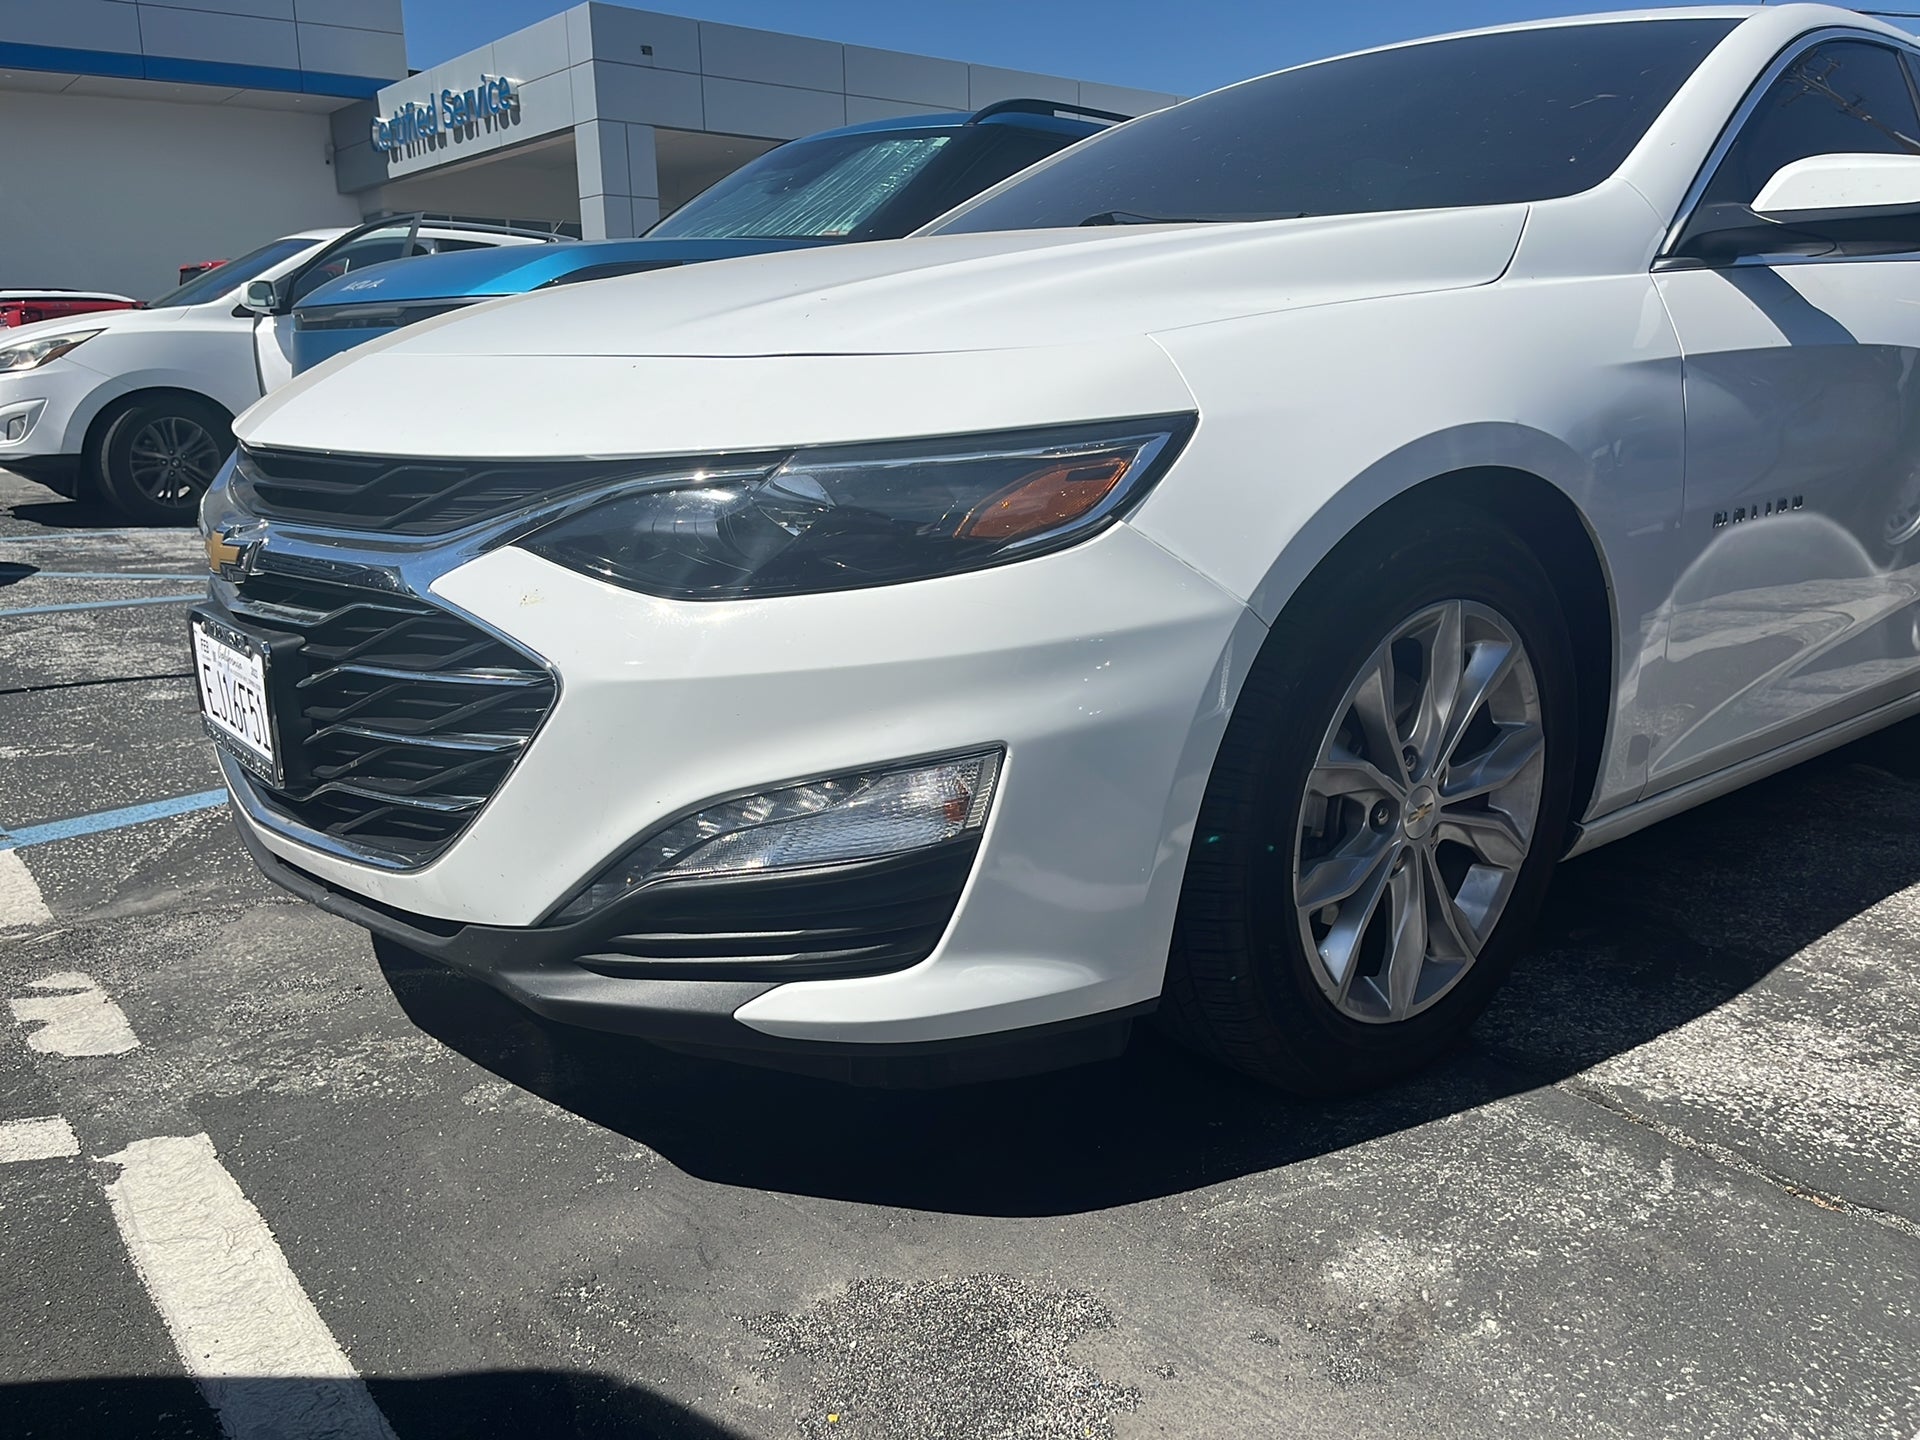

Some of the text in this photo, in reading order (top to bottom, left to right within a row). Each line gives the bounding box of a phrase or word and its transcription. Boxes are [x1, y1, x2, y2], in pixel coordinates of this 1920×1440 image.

[370, 74, 511, 152] Certified Service
[203, 663, 271, 752] EJ16F51
